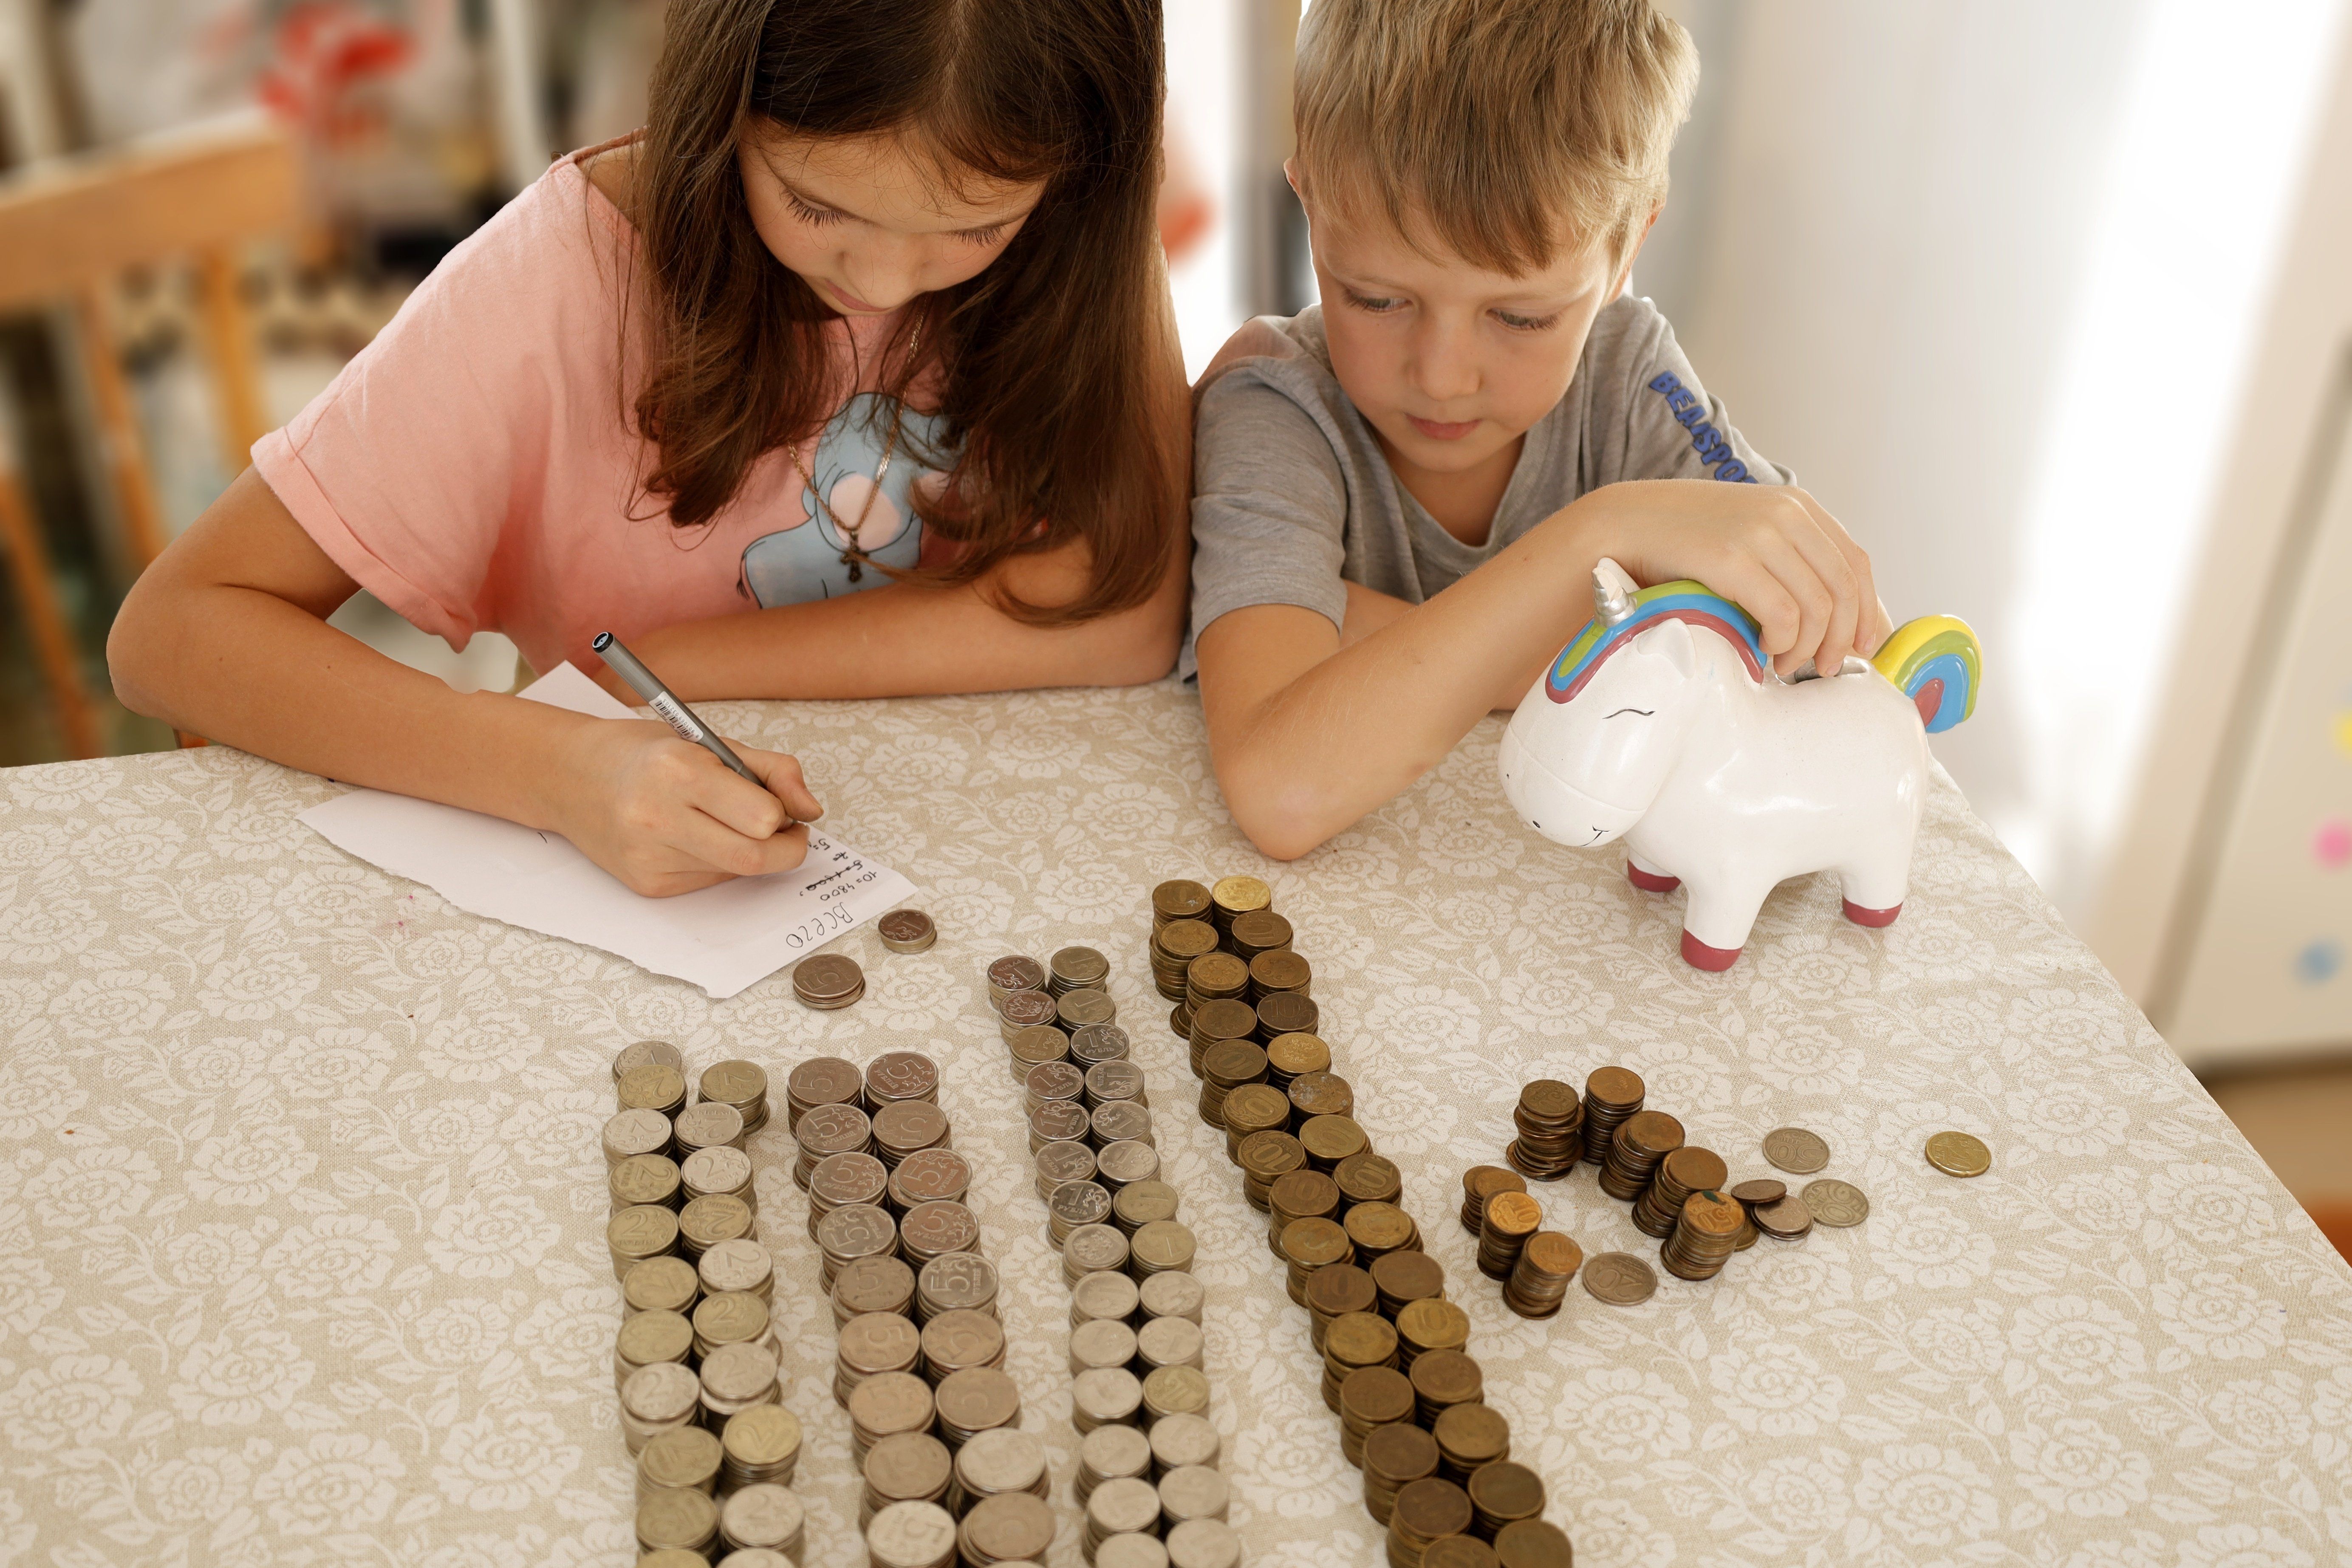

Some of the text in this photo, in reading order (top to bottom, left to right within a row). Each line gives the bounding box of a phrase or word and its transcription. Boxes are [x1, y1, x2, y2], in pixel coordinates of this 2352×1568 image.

[803, 972, 840, 990] 5
[1014, 968, 1035, 982] 1
[1264, 998, 1301, 1018] 10
[1029, 1031, 1044, 1048] 1
[1083, 1030, 1099, 1048] 1
[724, 1069, 756, 1085] 2
[887, 1059, 925, 1079] 5
[644, 1076, 673, 1098] 2
[795, 1074, 833, 1092] 5
[1034, 1075, 1057, 1088] 1
[1047, 1082, 1074, 1095] РУБЛЬ
[1245, 1089, 1284, 1116] 10
[630, 1118, 663, 1133] 2
[704, 1118, 727, 1139] 2
[808, 1114, 842, 1137] 5
[900, 1116, 928, 1141] 5
[1040, 1117, 1067, 1127] 1
[1066, 1114, 1080, 1134] РУБЛЬ
[1109, 1119, 1133, 1133] 1
[1041, 1154, 1060, 1173] РУБЛЬ
[1053, 1147, 1082, 1162] 1
[1116, 1146, 1134, 1163] 1
[1251, 1143, 1293, 1171] 10
[1770, 1143, 1824, 1168] 50
[1948, 1147, 1973, 1170] 20
[635, 1165, 672, 1181] 2
[695, 1156, 725, 1178] 2
[830, 1155, 864, 1184] 5
[902, 1164, 943, 1187] 5
[1354, 1161, 1394, 1188] 10
[1068, 1187, 1083, 1206] 1
[1285, 1176, 1321, 1201] 10
[1057, 1204, 1088, 1215] РУБЛЬ
[1822, 1184, 1866, 1223] 50
[623, 1212, 648, 1235] 2
[706, 1211, 735, 1235] 2
[921, 1209, 956, 1232] 5
[1697, 1206, 1735, 1229] 50
[829, 1226, 871, 1247] 5
[726, 1249, 761, 1269] 2
[856, 1264, 883, 1291] 5
[931, 1274, 970, 1293] 5
[1321, 1272, 1357, 1296] 10
[1595, 1268, 1644, 1299] 20
[711, 1296, 738, 1322] 2
[1413, 1306, 1450, 1331] 10
[867, 1322, 908, 1346] 5
[722, 1353, 748, 1378] 2
[641, 1370, 669, 1399] 2
